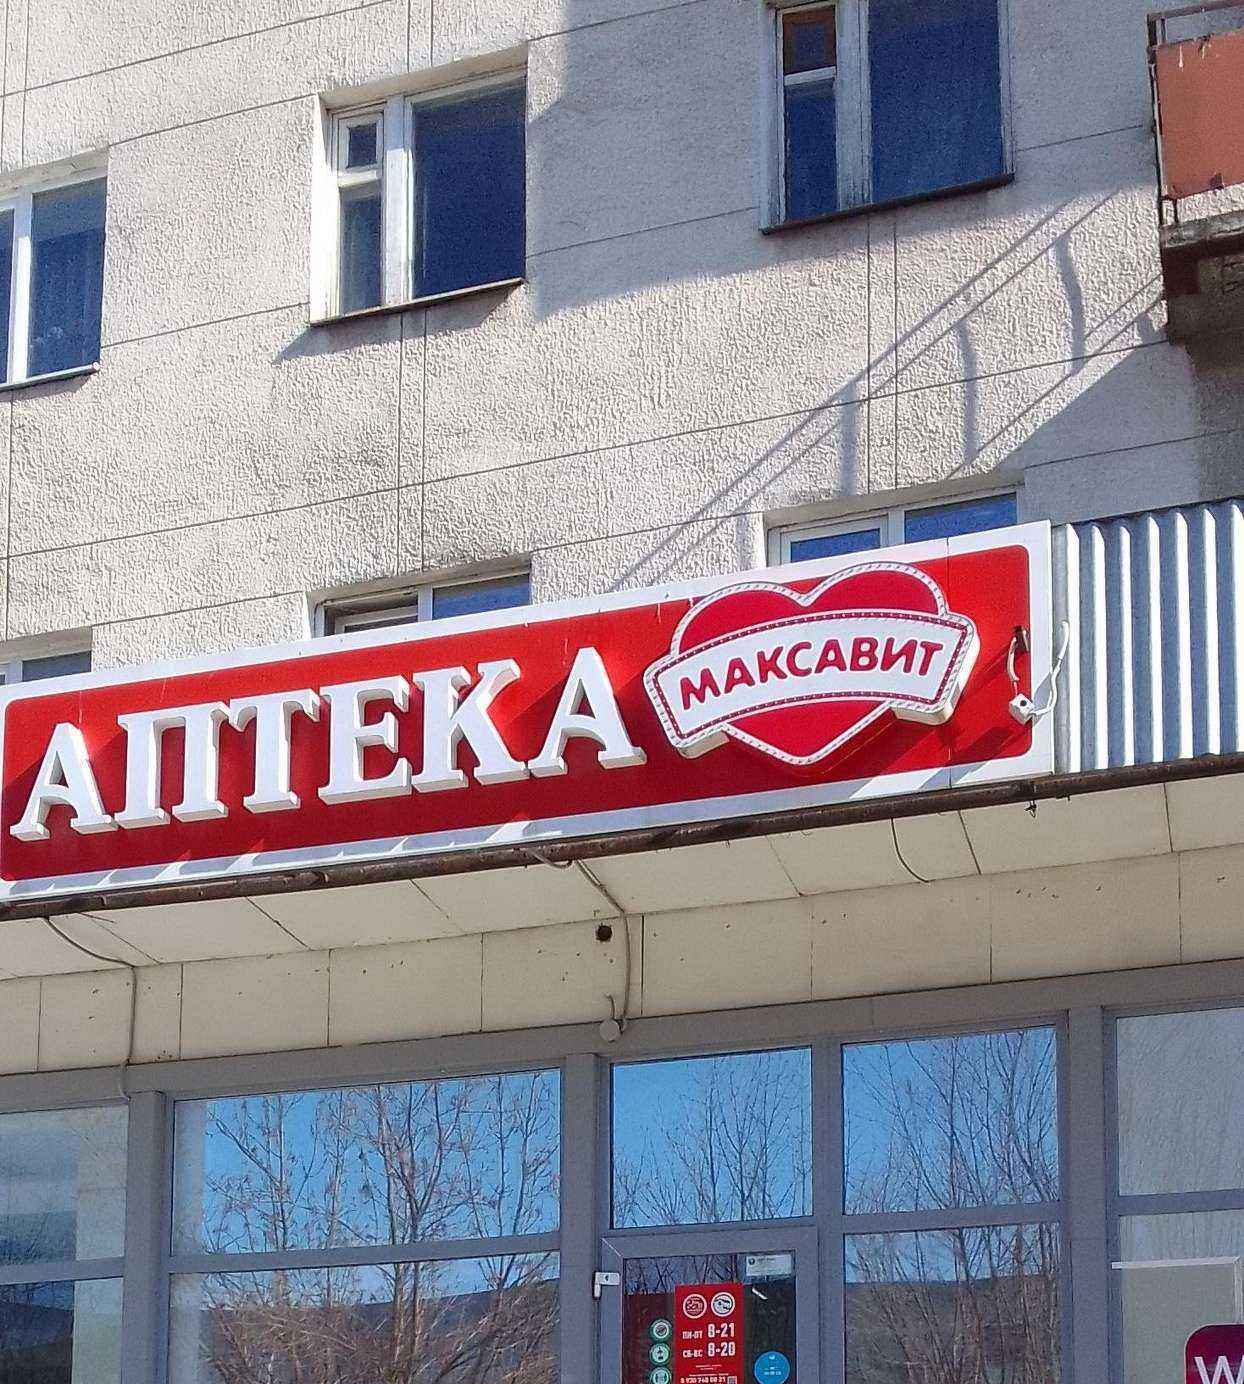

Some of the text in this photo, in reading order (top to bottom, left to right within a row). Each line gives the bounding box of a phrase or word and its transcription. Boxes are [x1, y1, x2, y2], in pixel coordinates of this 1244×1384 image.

[678, 637, 944, 711] МАКСАВИТ
[10, 646, 647, 841] АПТЕКА
[707, 1322, 735, 1338] 8-21
[707, 1341, 736, 1357] 8-20
